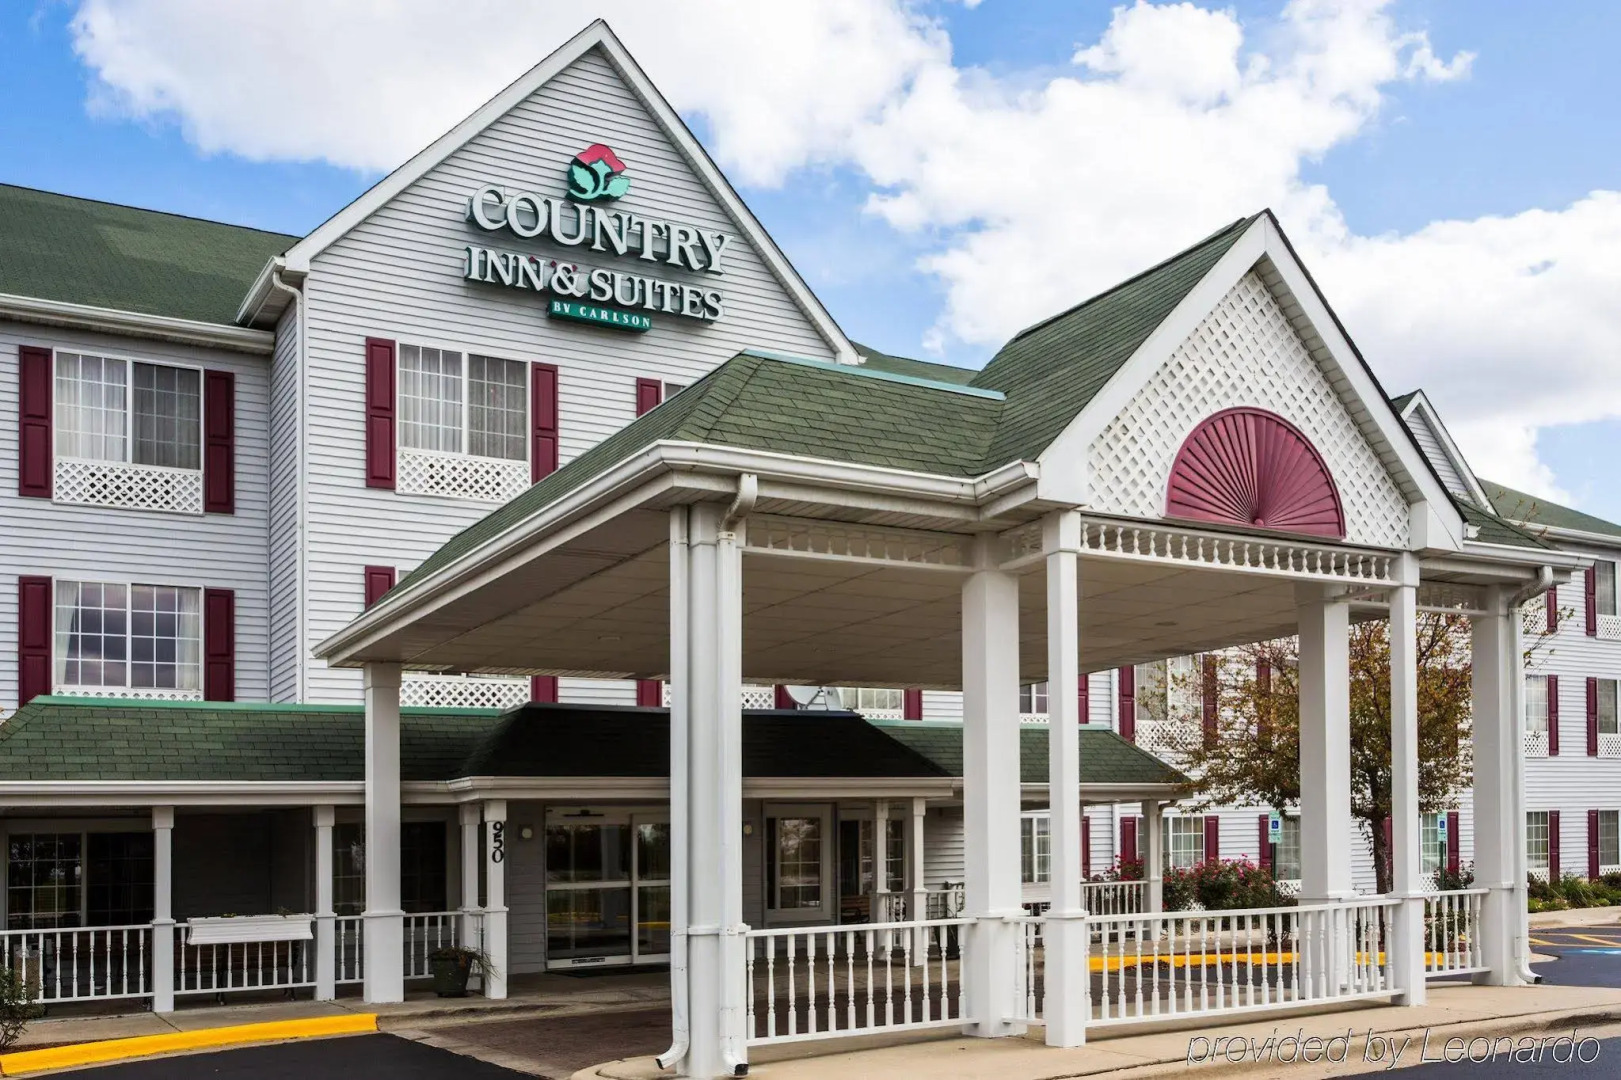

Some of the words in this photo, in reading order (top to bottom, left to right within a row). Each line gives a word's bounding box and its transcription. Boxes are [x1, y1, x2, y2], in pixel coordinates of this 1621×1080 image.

[471, 183, 735, 276] COUNTRY
[466, 245, 547, 293] INN
[550, 262, 586, 299] &
[589, 268, 726, 323] SUITES
[579, 306, 651, 328] CARLSON
[492, 821, 504, 864] 950
